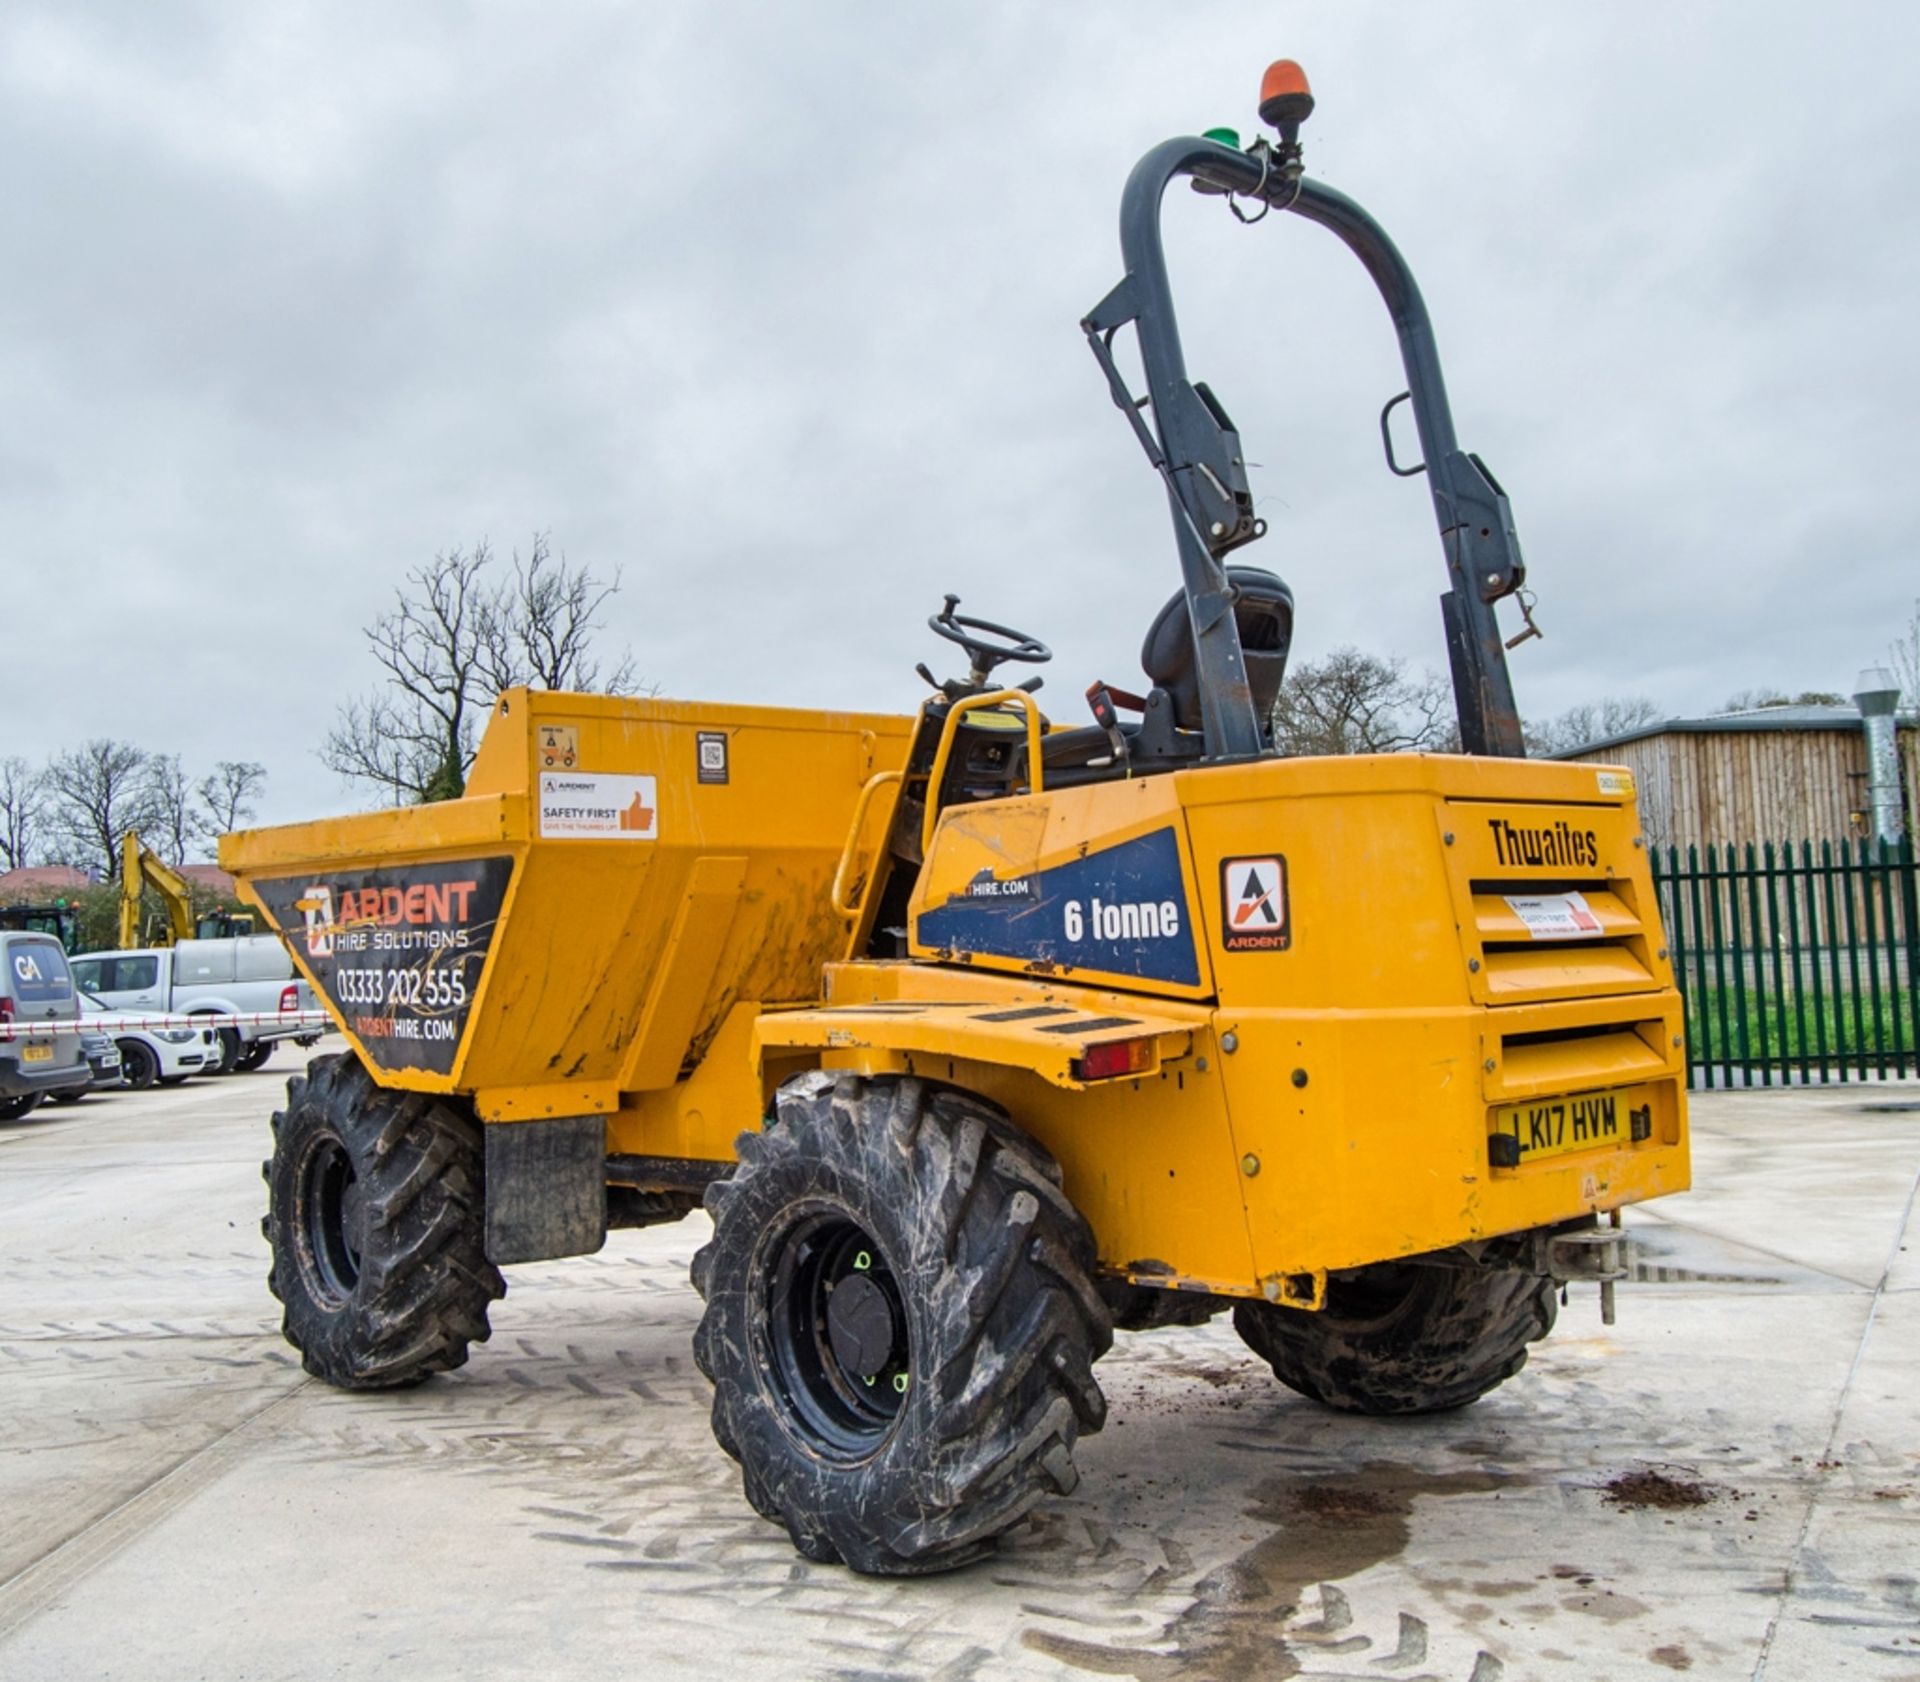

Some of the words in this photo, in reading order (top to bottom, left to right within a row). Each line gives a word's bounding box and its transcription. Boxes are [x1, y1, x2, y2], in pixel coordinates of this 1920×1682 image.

[543, 807, 583, 819] SAFETY
[587, 808, 617, 819] FIRST
[1488, 819, 1599, 868] Thwaites
[338, 881, 477, 926] ARDENT
[1064, 900, 1083, 942] 6
[1092, 898, 1179, 940] tonne
[336, 933, 367, 951] HIRE
[373, 929, 469, 950] SOLUTIONS
[1227, 936, 1287, 949] ARDENT
[337, 969, 383, 1004] 03333
[387, 970, 421, 1005] 202
[425, 969, 466, 1006] 555
[1513, 1106, 1565, 1152] LK17
[1572, 1097, 1617, 1142] HVM
